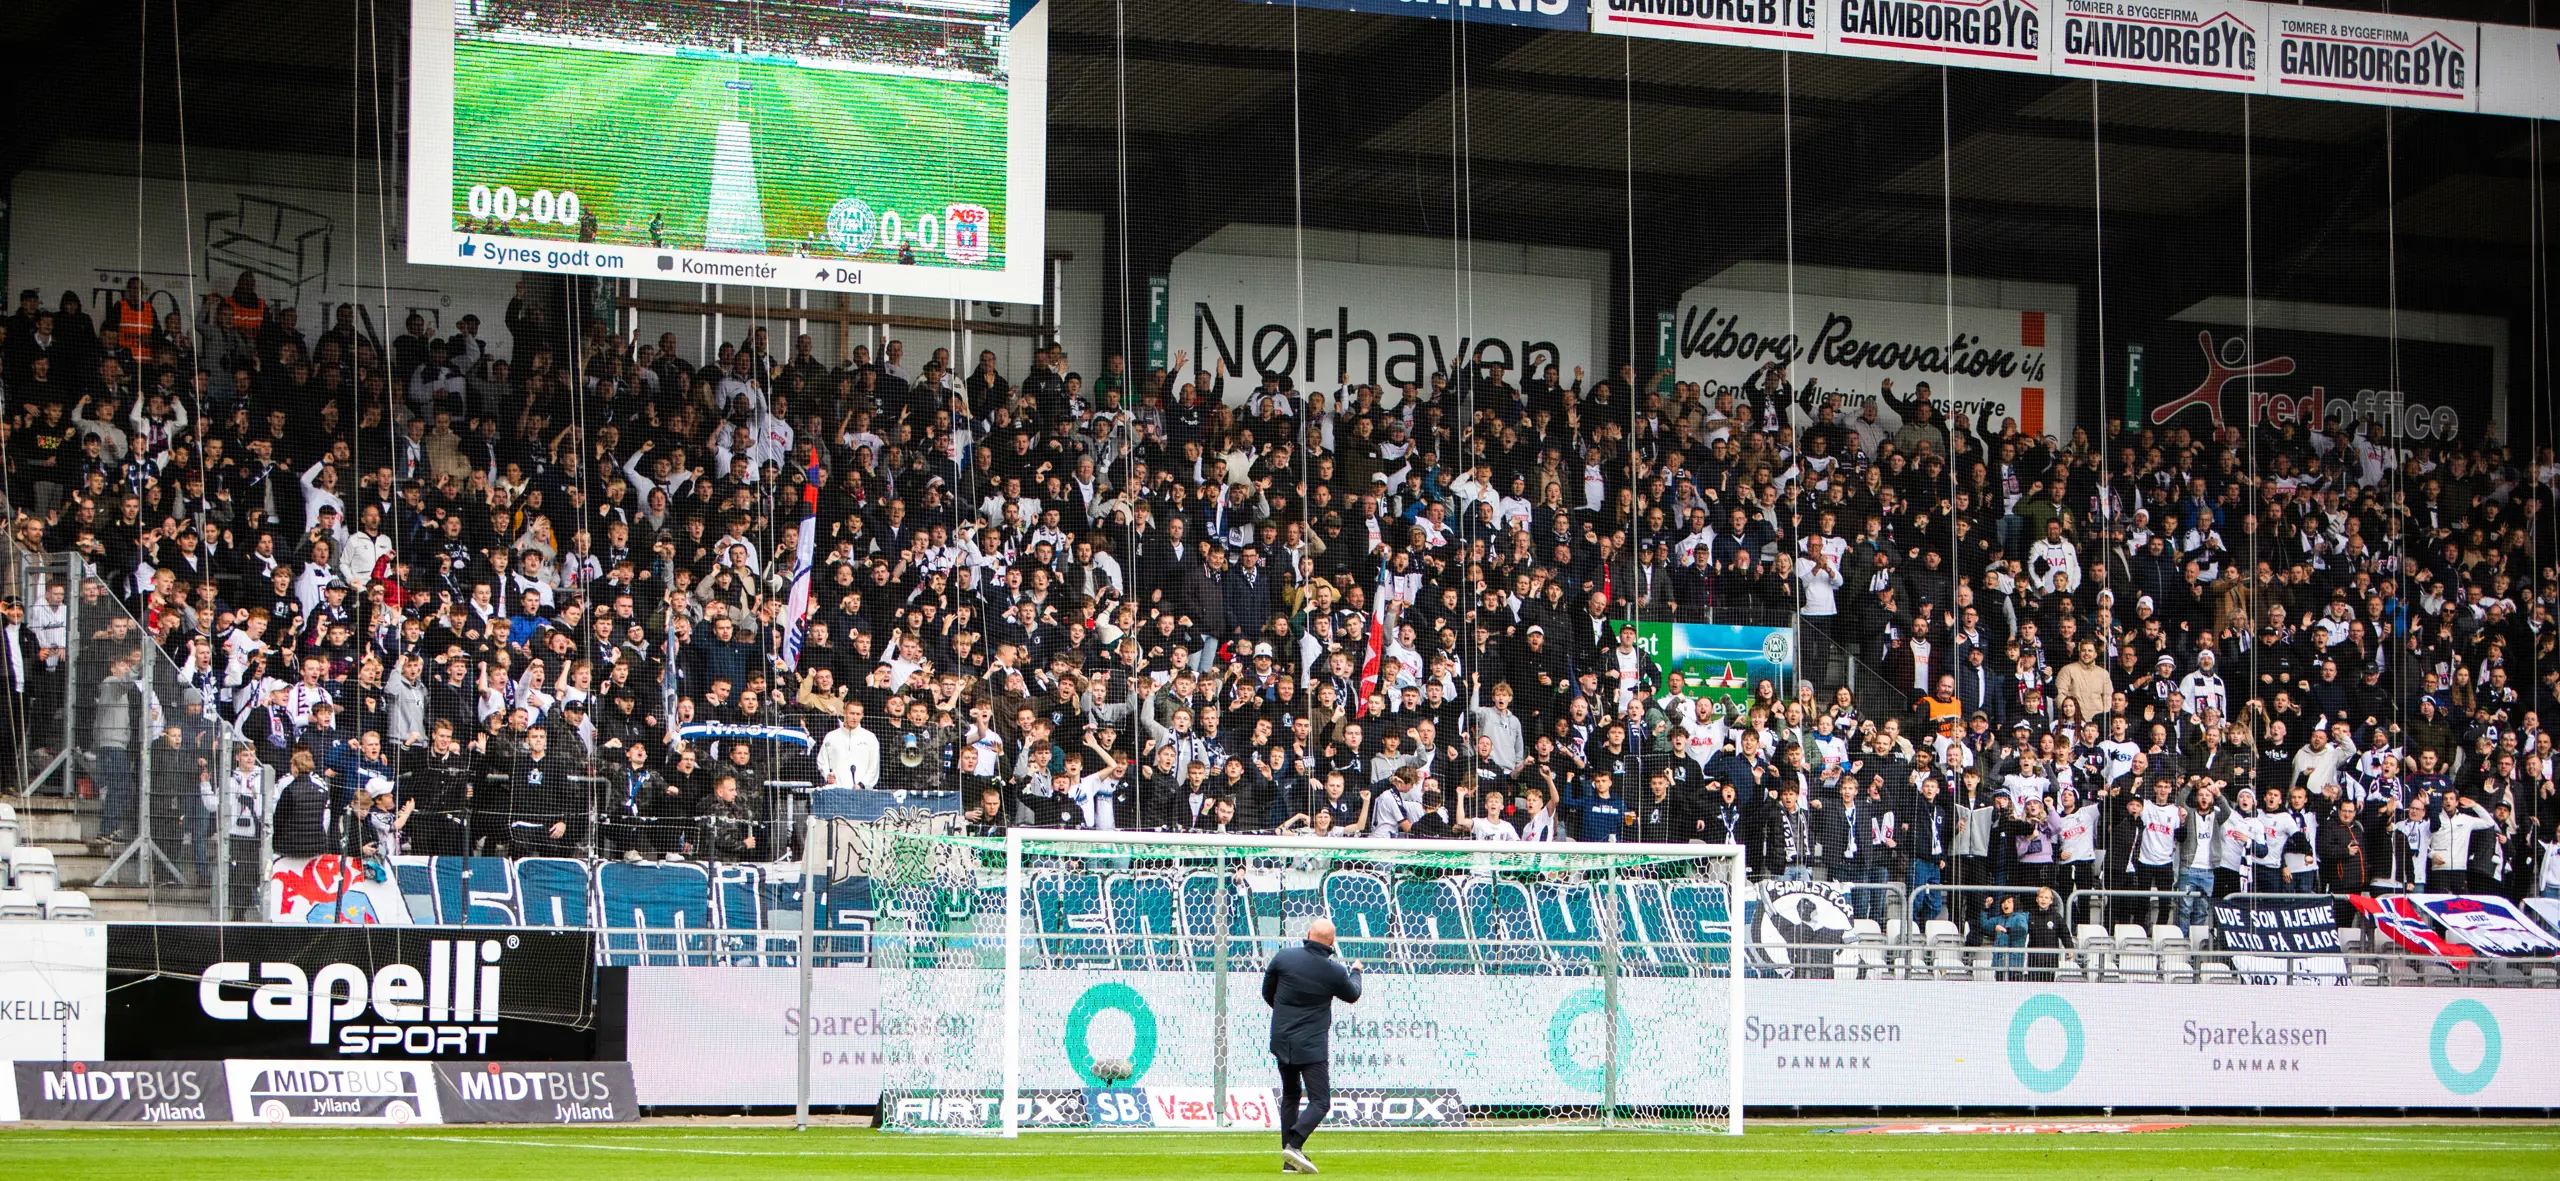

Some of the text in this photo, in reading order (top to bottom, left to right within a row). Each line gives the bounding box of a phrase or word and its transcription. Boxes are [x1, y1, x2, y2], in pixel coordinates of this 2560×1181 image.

[1609, 0, 1815, 28] ORGBYG
[1840, 0, 2038, 50] GAMBORGBYG
[2067, 0, 2199, 23] TØMRER & BYGGEFIRMA
[2065, 18, 2256, 71] GAMBORGBYG
[2282, 20, 2409, 42] TØMRER & BYGGEFIRMA
[2280, 39, 2465, 90] GAMBORGBYG
[468, 184, 580, 227] 00:00
[483, 242, 624, 271] Synes godt om
[681, 257, 778, 280] Kommentér
[836, 268, 862, 285] Del
[1151, 287, 1164, 323] F
[1193, 301, 1561, 391] Nørhaven
[1660, 322, 1673, 356] F
[1680, 304, 1804, 366] Viborg
[1807, 311, 2018, 378] Renovation
[2129, 354, 2141, 388] F
[2249, 386, 2459, 441] redoffice
[1775, 880, 1829, 899] SAMLET
[2214, 906, 2245, 927] UDE
[2281, 905, 2335, 928] HJEMME
[2225, 929, 2342, 951] ALTID PÅ PLADS
[199, 939, 501, 1045] capelli
[340, 1026, 499, 1054] SPORT
[1744, 1015, 1901, 1046] Sparekassen
[2182, 1019, 2328, 1049] Sparekassen
[1777, 1056, 1872, 1069] DANMARK
[2213, 1058, 2301, 1072] DANMARK
[141, 1102, 206, 1123] Jylland
[312, 1097, 361, 1115] Jylland
[554, 1102, 613, 1123] Jylland
[1098, 1092, 1140, 1122] SB
[1299, 1097, 1446, 1121] RTOX
